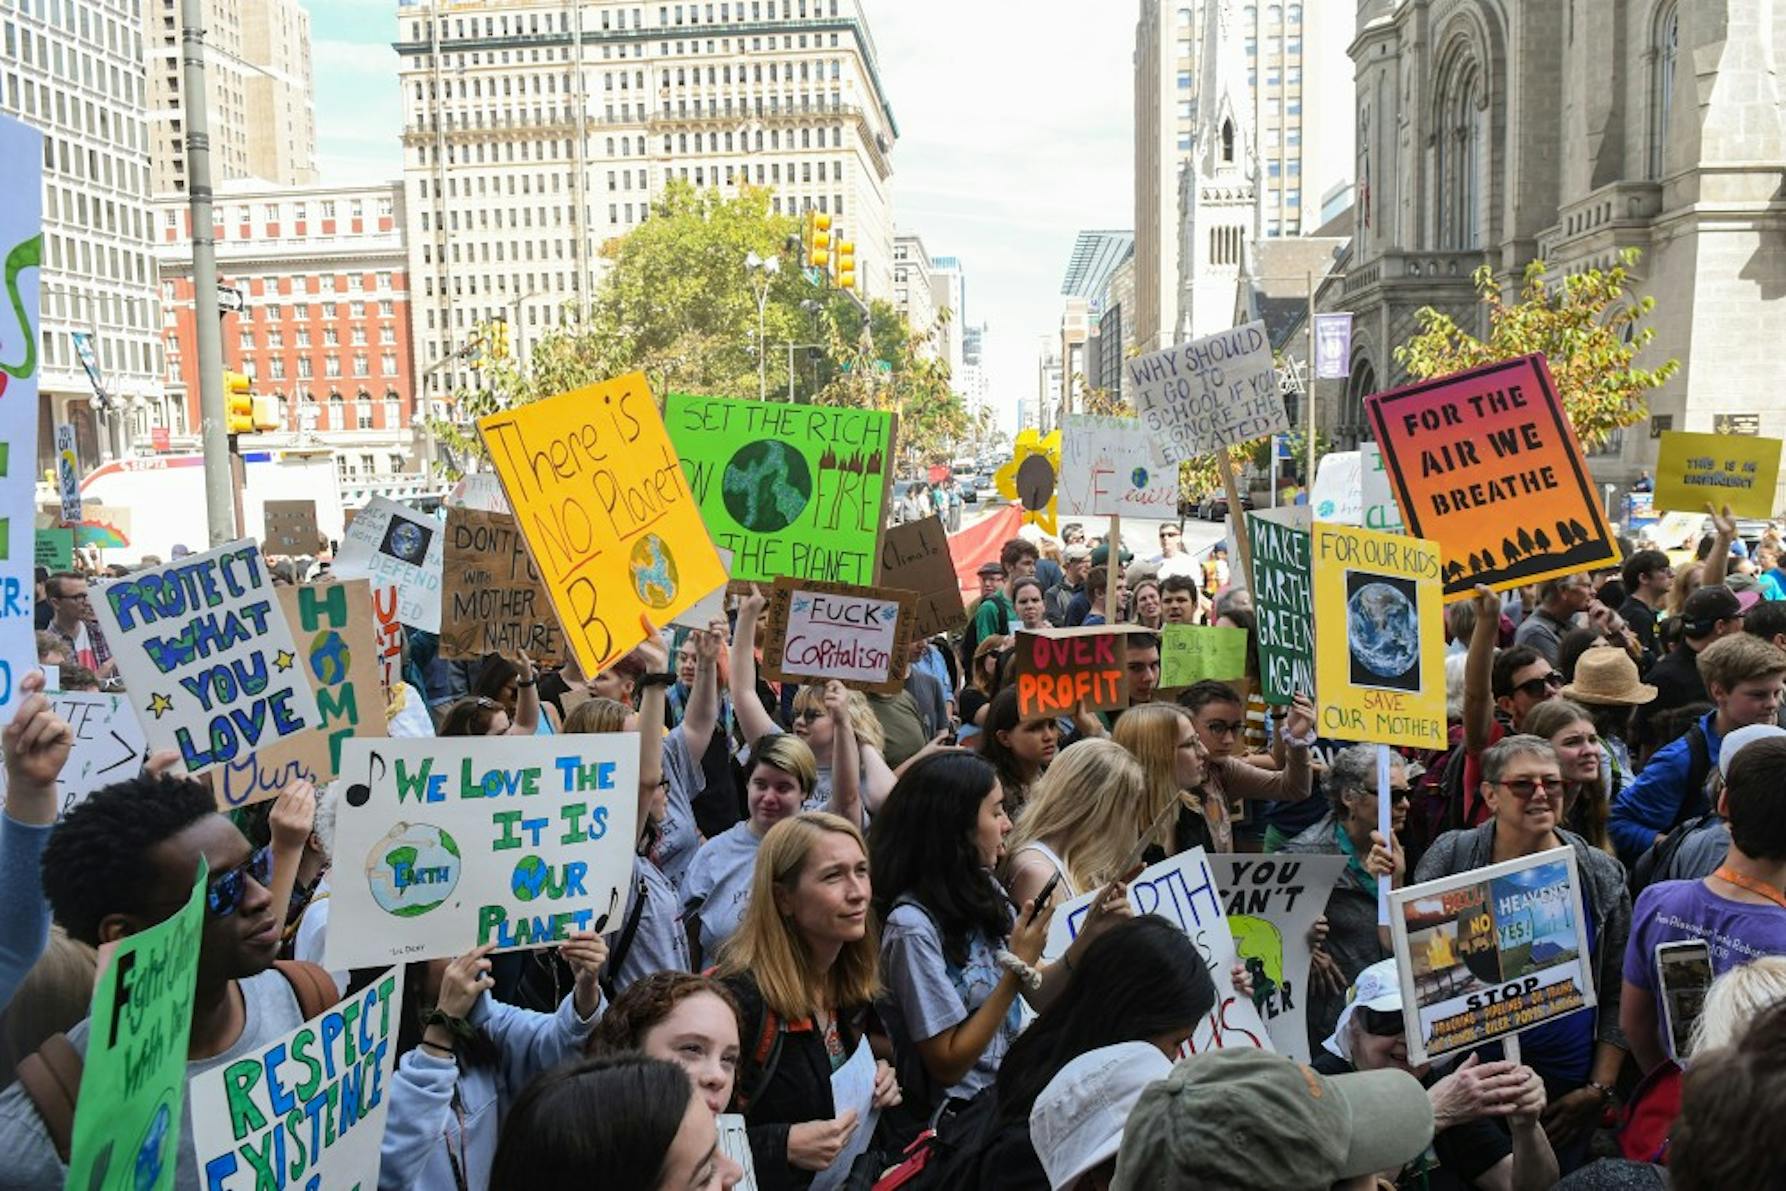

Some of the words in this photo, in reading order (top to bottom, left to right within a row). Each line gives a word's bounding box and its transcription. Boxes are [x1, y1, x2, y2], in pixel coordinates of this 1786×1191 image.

[1130, 351, 1177, 386] WHY
[1186, 329, 1263, 372] SHOULD
[1140, 390, 1156, 412] I
[1164, 379, 1190, 404] GO
[1196, 368, 1224, 391] TO
[1148, 391, 1225, 431] SCHOOL
[1229, 380, 1243, 400] IF
[1250, 369, 1276, 394] YOU
[1403, 403, 1463, 437] FOR
[1468, 385, 1528, 418] THE
[683, 403, 736, 432] SET
[747, 406, 801, 436] THE
[807, 411, 883, 447] RICH
[1154, 407, 1236, 444] IGNORE
[1242, 394, 1279, 416] THE
[484, 420, 607, 502] There
[604, 392, 640, 446] is
[1422, 440, 1481, 478] AIR
[1488, 423, 1543, 458] WE
[1725, 460, 1736, 471] IS
[533, 498, 592, 577] NO
[593, 445, 685, 541] Planet
[813, 449, 883, 532] FIRE
[1430, 466, 1558, 516] BREATHE
[720, 532, 785, 577] THE
[792, 542, 868, 585] PLANET
[1253, 520, 1307, 570] MAKE
[1321, 532, 1360, 565] FOR
[1364, 539, 1399, 570] OUR
[1404, 546, 1439, 579] KIDS
[106, 545, 263, 633] PROTECT
[368, 554, 438, 591] DEFEND
[1252, 559, 1312, 616] EARTH
[454, 589, 536, 623] MOTHER
[567, 577, 613, 664] B
[810, 598, 881, 625] FUCK
[1256, 604, 1314, 654] GREEN
[142, 600, 271, 673] WHAT
[483, 621, 560, 654] NATURE
[1033, 635, 1115, 669] OVER
[179, 650, 268, 712] YOU
[1018, 670, 1121, 716] PROFIT
[1268, 654, 1315, 698] AGAIN
[1363, 691, 1406, 711] SAVE
[175, 688, 305, 773] LOVE
[1324, 706, 1365, 731] OUR
[1377, 713, 1441, 740] MOTHER
[394, 757, 448, 805] WE
[460, 757, 542, 799] LOVE
[555, 755, 616, 792] THE
[492, 809, 549, 851] IT
[560, 802, 608, 847] IS
[511, 855, 588, 901] OUR
[1232, 861, 1302, 886] YOU
[1500, 882, 1570, 917] HEAVENS
[476, 904, 593, 949] PLANET
[1470, 913, 1491, 934] NO
[1497, 920, 1530, 941] YES!
[1466, 977, 1539, 1012] STOP
[224, 976, 395, 1141] RESPECT
[206, 1039, 388, 1191] EXISTENCE
